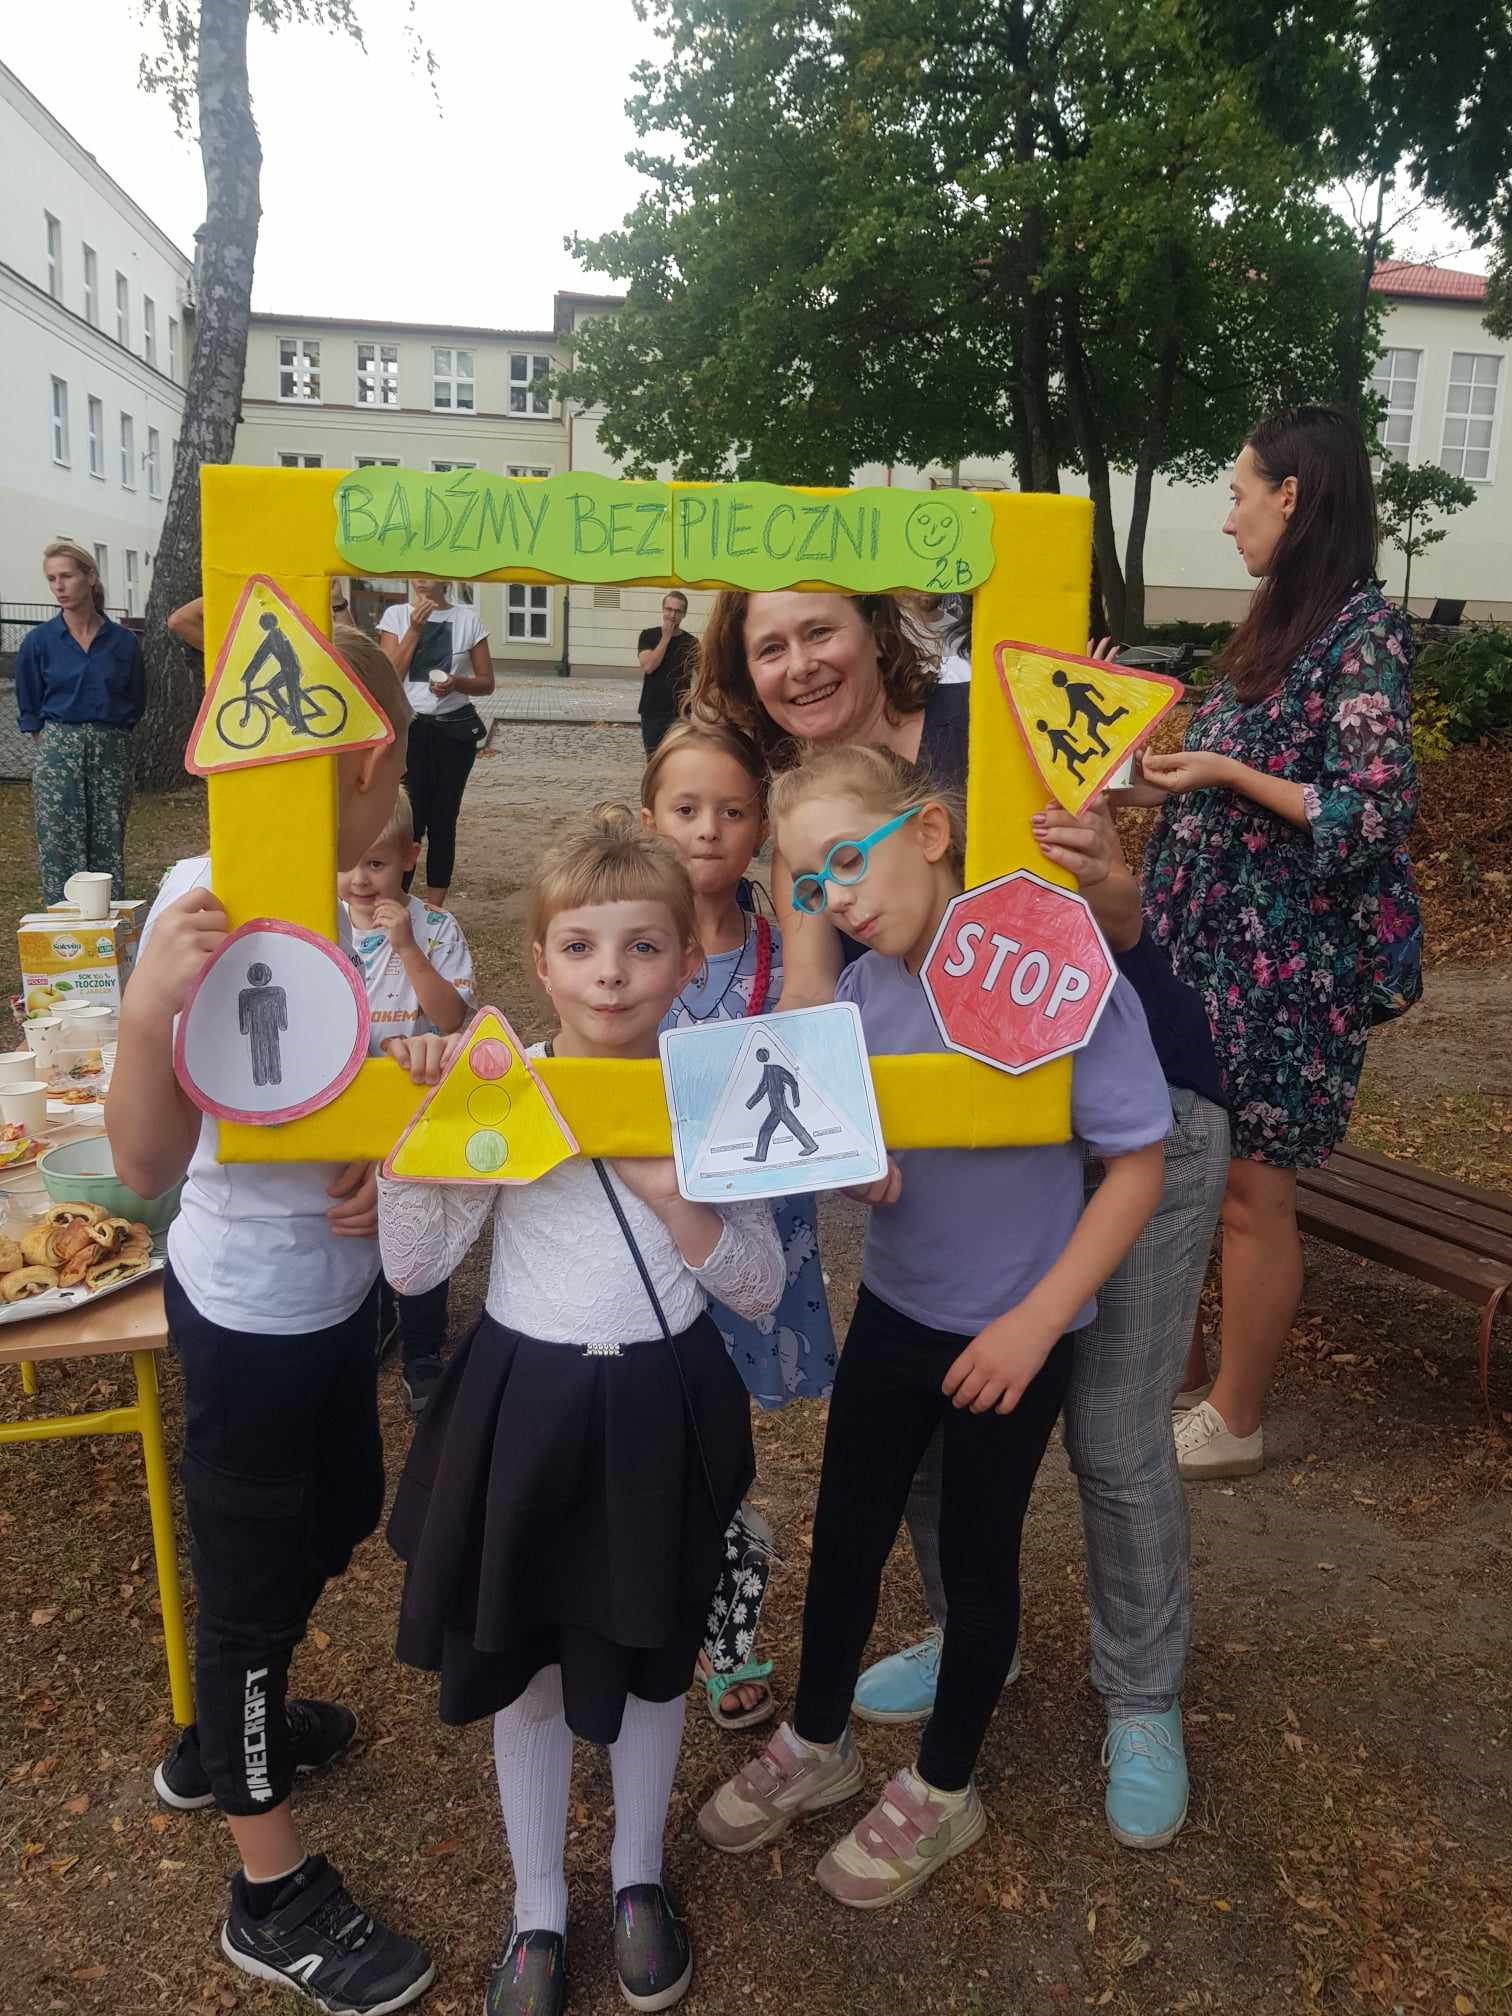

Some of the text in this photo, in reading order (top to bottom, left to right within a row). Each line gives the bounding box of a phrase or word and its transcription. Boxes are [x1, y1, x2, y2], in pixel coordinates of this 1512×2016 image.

[927, 558, 973, 590] 2B
[75, 979, 116, 989] TŁOCZONY
[943, 921, 1091, 1021] STOP
